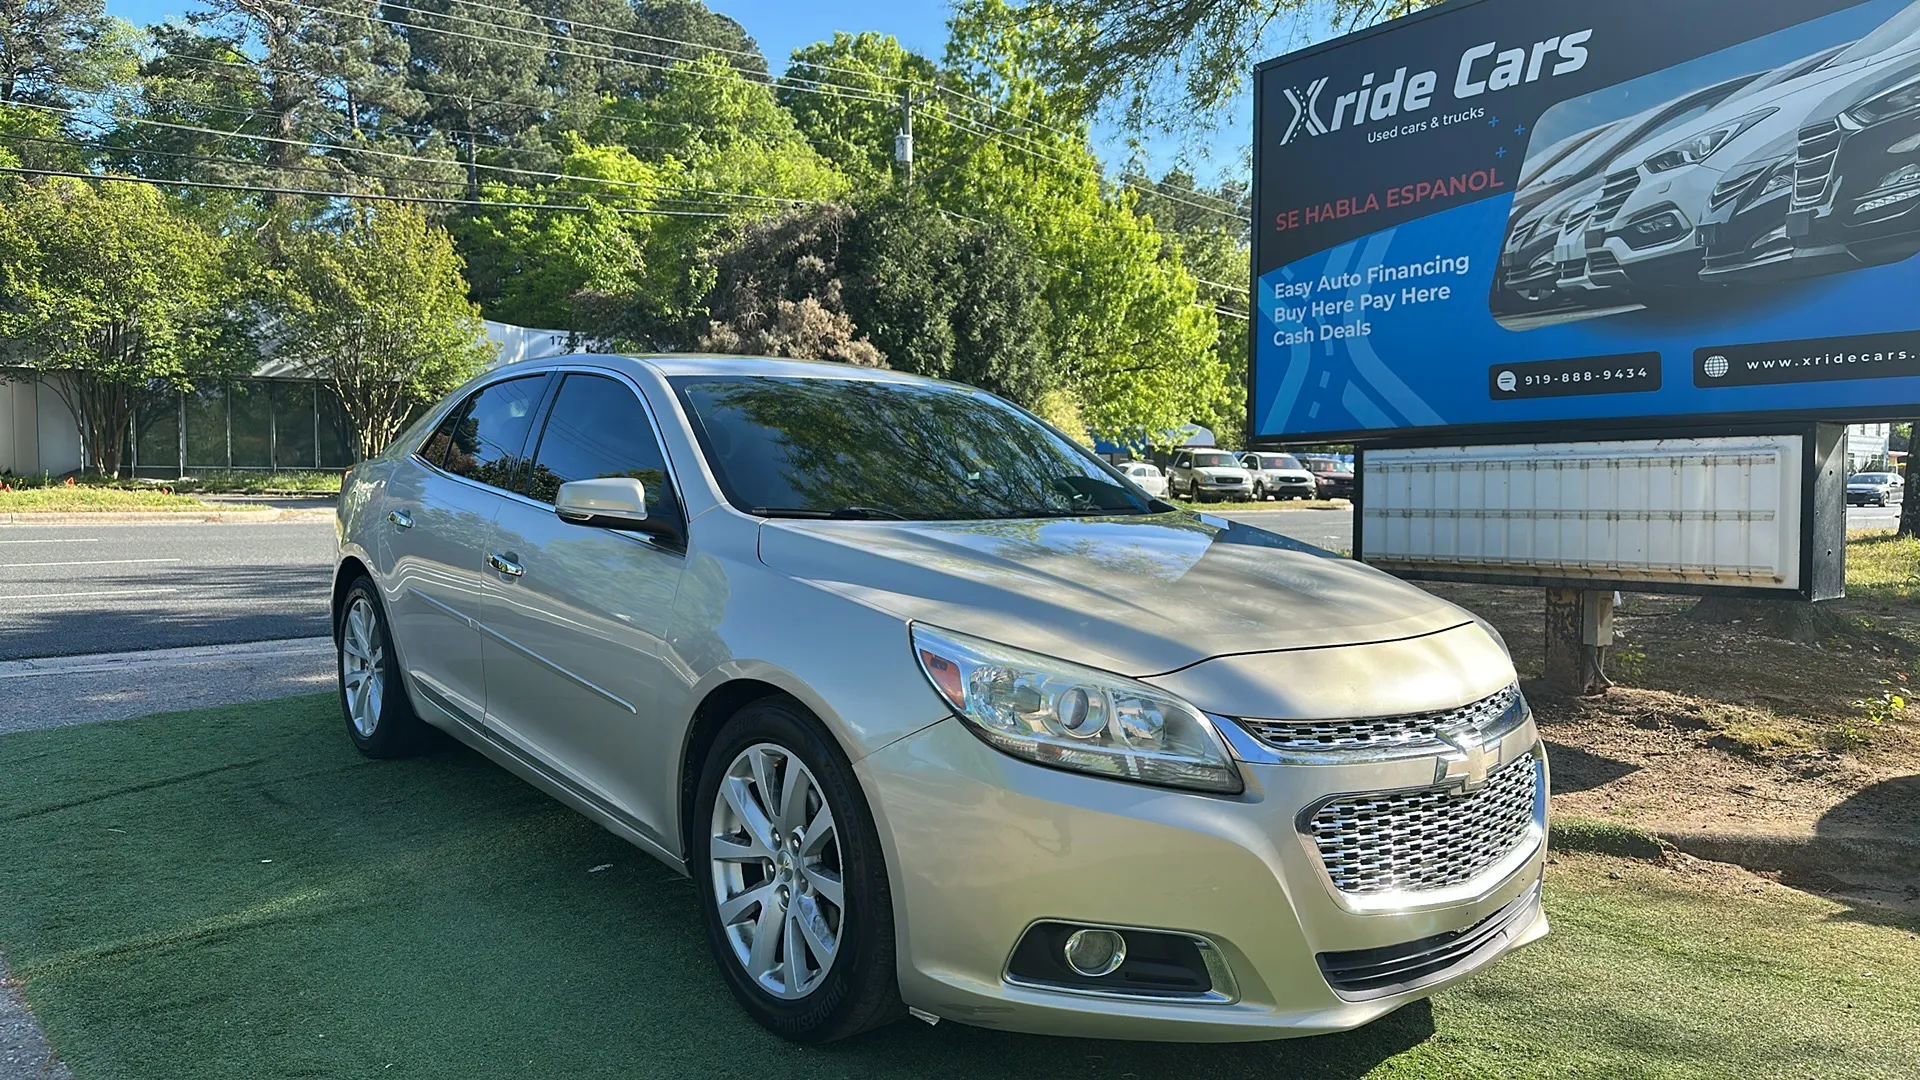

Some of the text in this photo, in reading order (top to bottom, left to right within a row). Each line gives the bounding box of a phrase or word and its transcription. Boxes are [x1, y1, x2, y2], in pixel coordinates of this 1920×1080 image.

[1453, 29, 1592, 100] Cars
[1367, 106, 1485, 144] Used cars & trucks
[1275, 168, 1504, 233] SE HABLA ESPANOL
[1275, 255, 1469, 299] Easy Auto Financing
[1274, 285, 1451, 324] Buy Here Pay Here
[1273, 319, 1371, 347] Cash Deals
[1524, 367, 1648, 386] 919-888-9434
[1746, 350, 1920, 370] www.xridecars.
